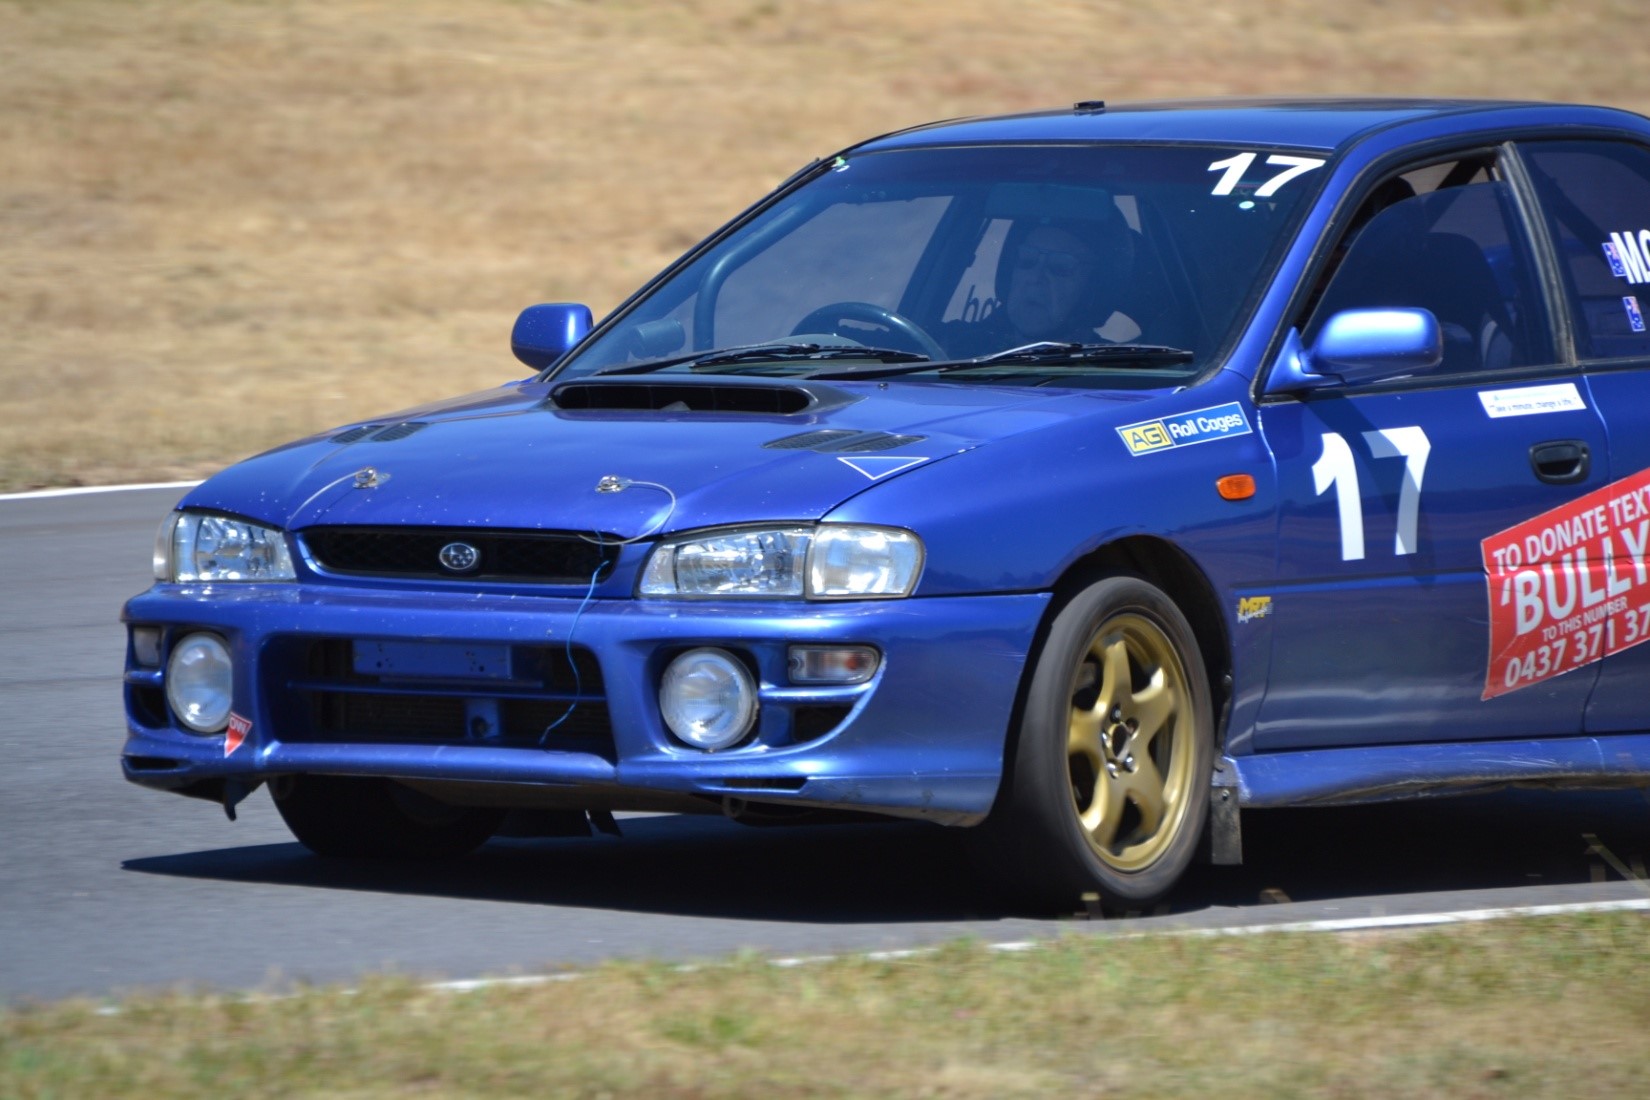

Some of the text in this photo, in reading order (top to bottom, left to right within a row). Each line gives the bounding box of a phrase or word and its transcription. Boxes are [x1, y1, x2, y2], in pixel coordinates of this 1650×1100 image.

[1207, 152, 1326, 197] 17
[1131, 413, 1243, 448] AGI Roll Cages
[1311, 426, 1431, 561] 17
[1493, 543, 1522, 576] TO
[1525, 505, 1609, 564] DONATE
[1542, 596, 1628, 642] TO THIS NUMBER
[1504, 638, 1567, 688] 0437
[1572, 618, 1615, 664] 371
